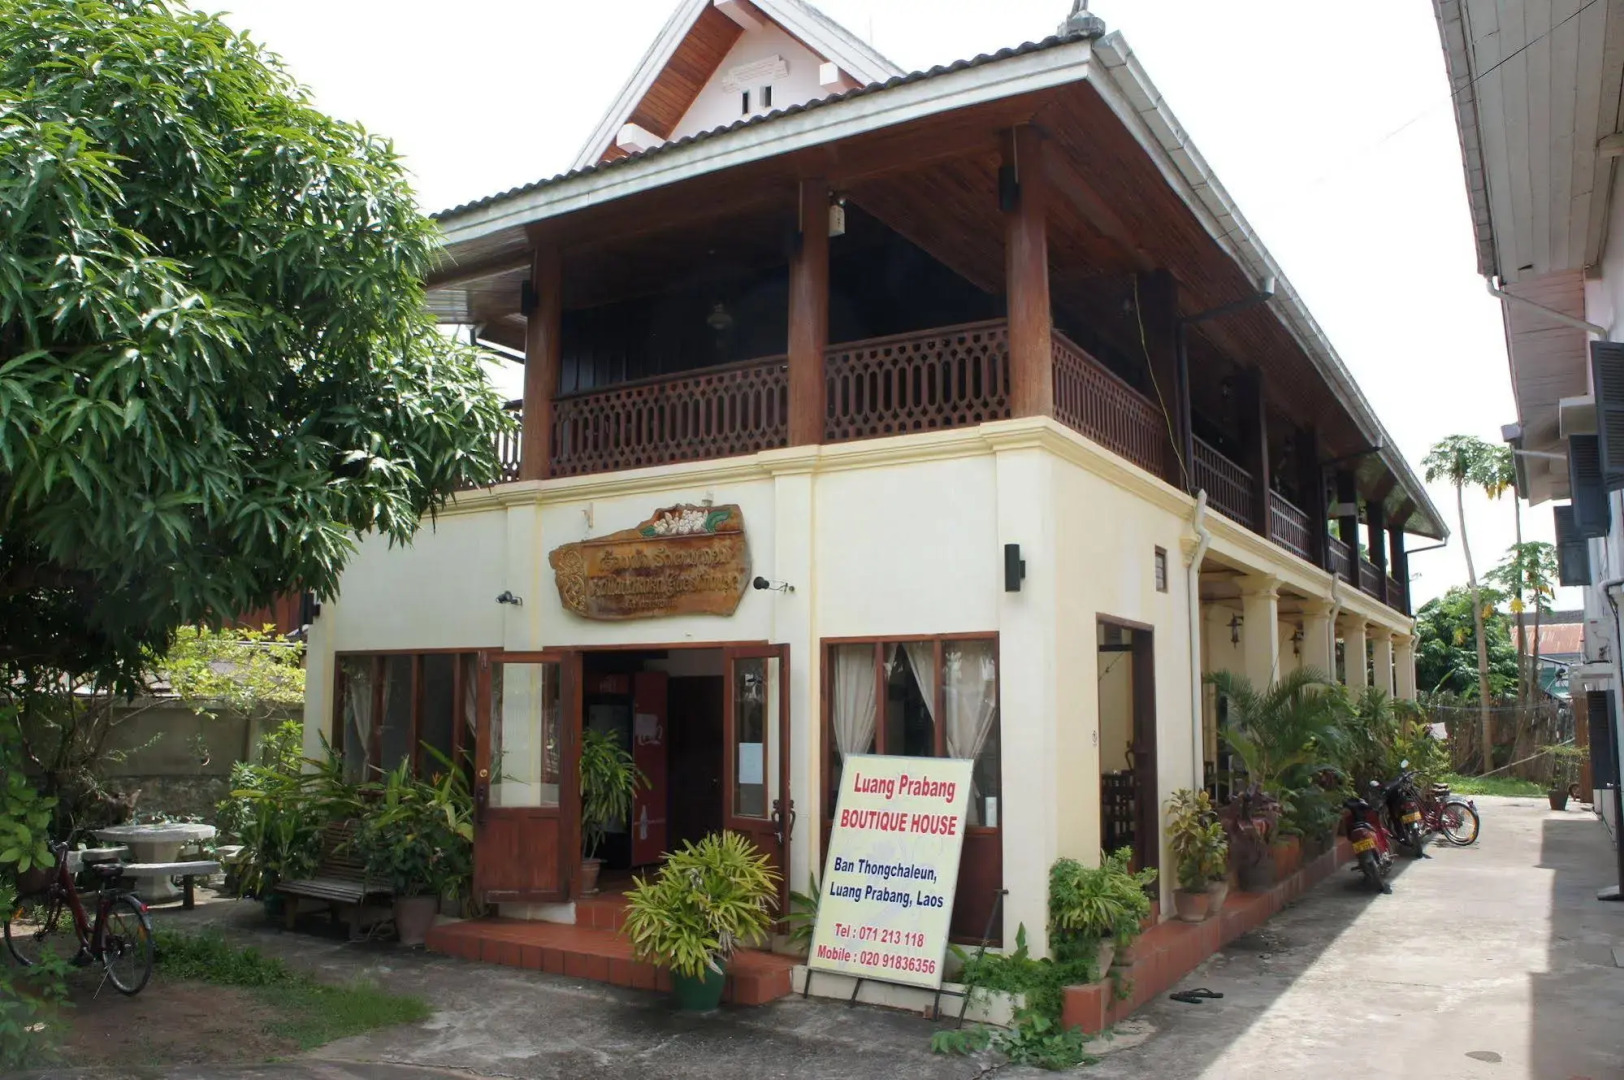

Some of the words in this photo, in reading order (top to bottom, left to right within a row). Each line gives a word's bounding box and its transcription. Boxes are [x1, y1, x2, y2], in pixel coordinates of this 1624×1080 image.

[854, 773, 895, 799] Luang
[899, 775, 955, 803] Prabang
[841, 809, 908, 832] BOUTIQUE
[911, 814, 957, 835] HOUSE
[834, 857, 854, 872] Ban
[859, 859, 936, 884] Thongchaleun,
[830, 882, 862, 902] Luang
[865, 885, 912, 908] Prabang,
[917, 892, 943, 907] Laos
[836, 923, 850, 937] Tel
[859, 927, 877, 941] 071
[881, 929, 901, 944] 213
[905, 933, 924, 947] 118
[817, 945, 851, 962] Mobile
[860, 953, 879, 966] 020
[883, 956, 935, 974] 91836356
